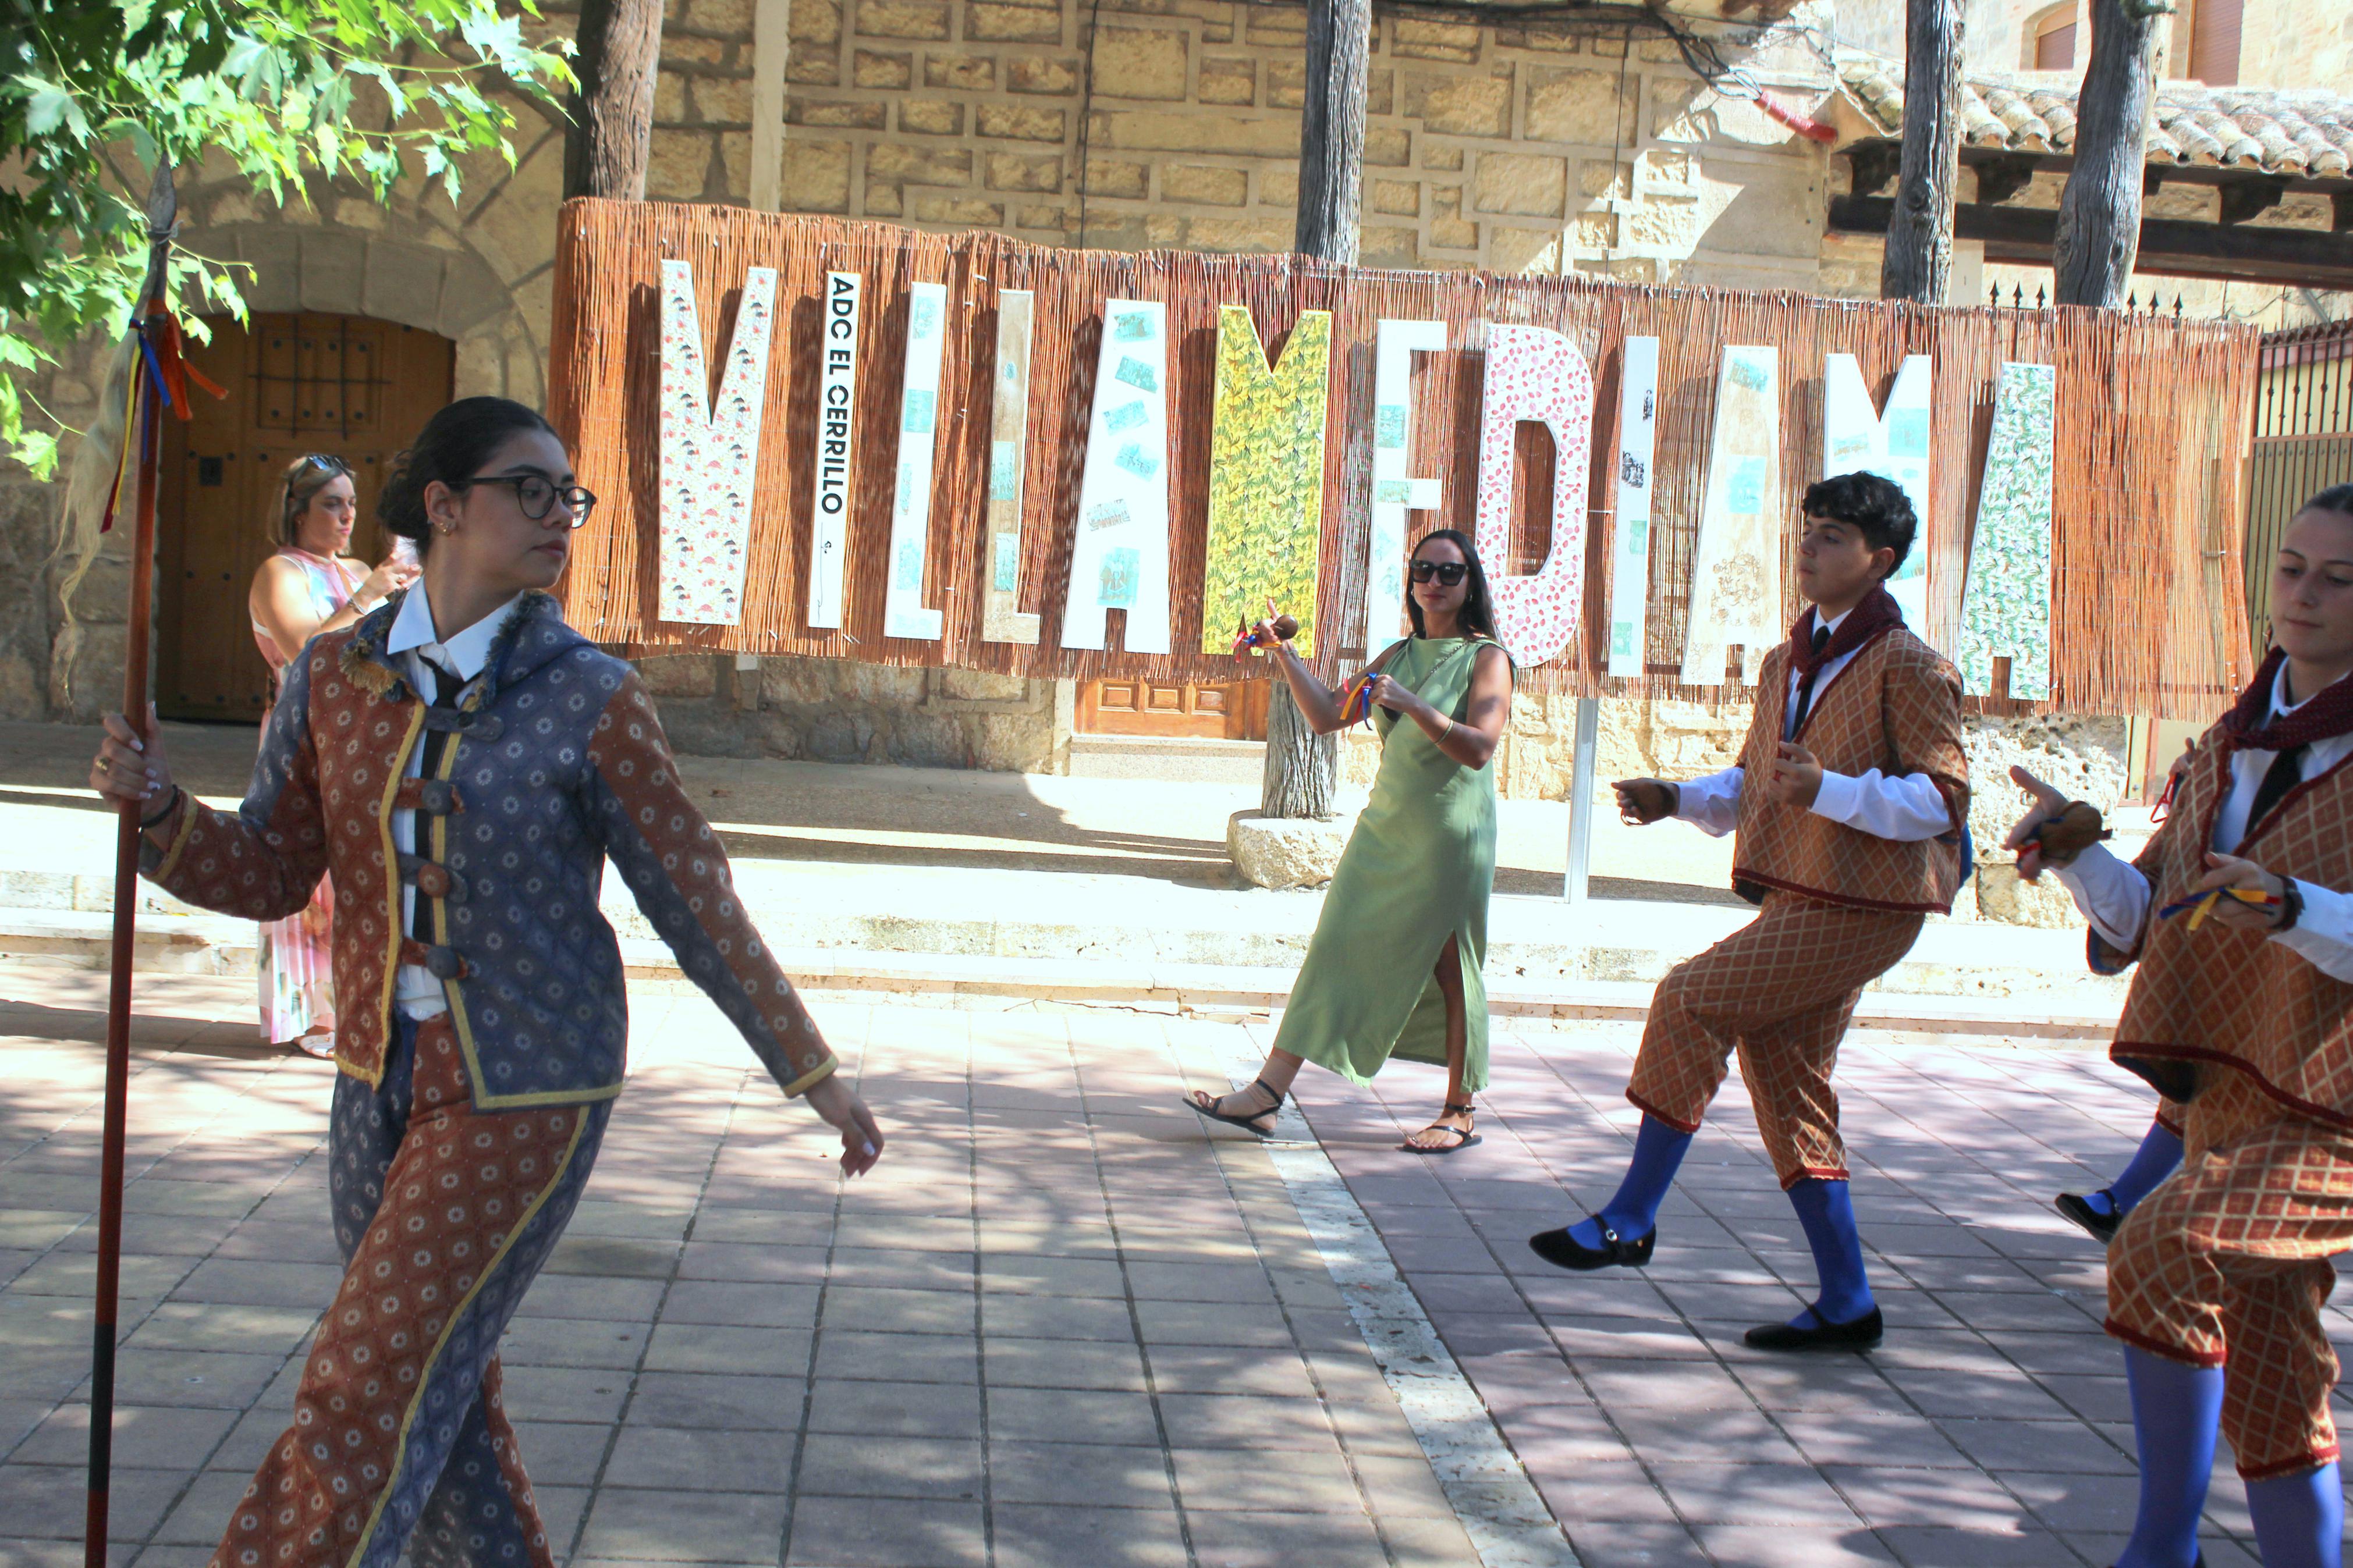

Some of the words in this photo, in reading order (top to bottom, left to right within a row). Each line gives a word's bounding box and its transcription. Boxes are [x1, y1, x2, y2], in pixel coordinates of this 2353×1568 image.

[831, 276, 854, 339] ADC
[829, 350, 850, 375] EL
[821, 385, 849, 514] CERRILLO
